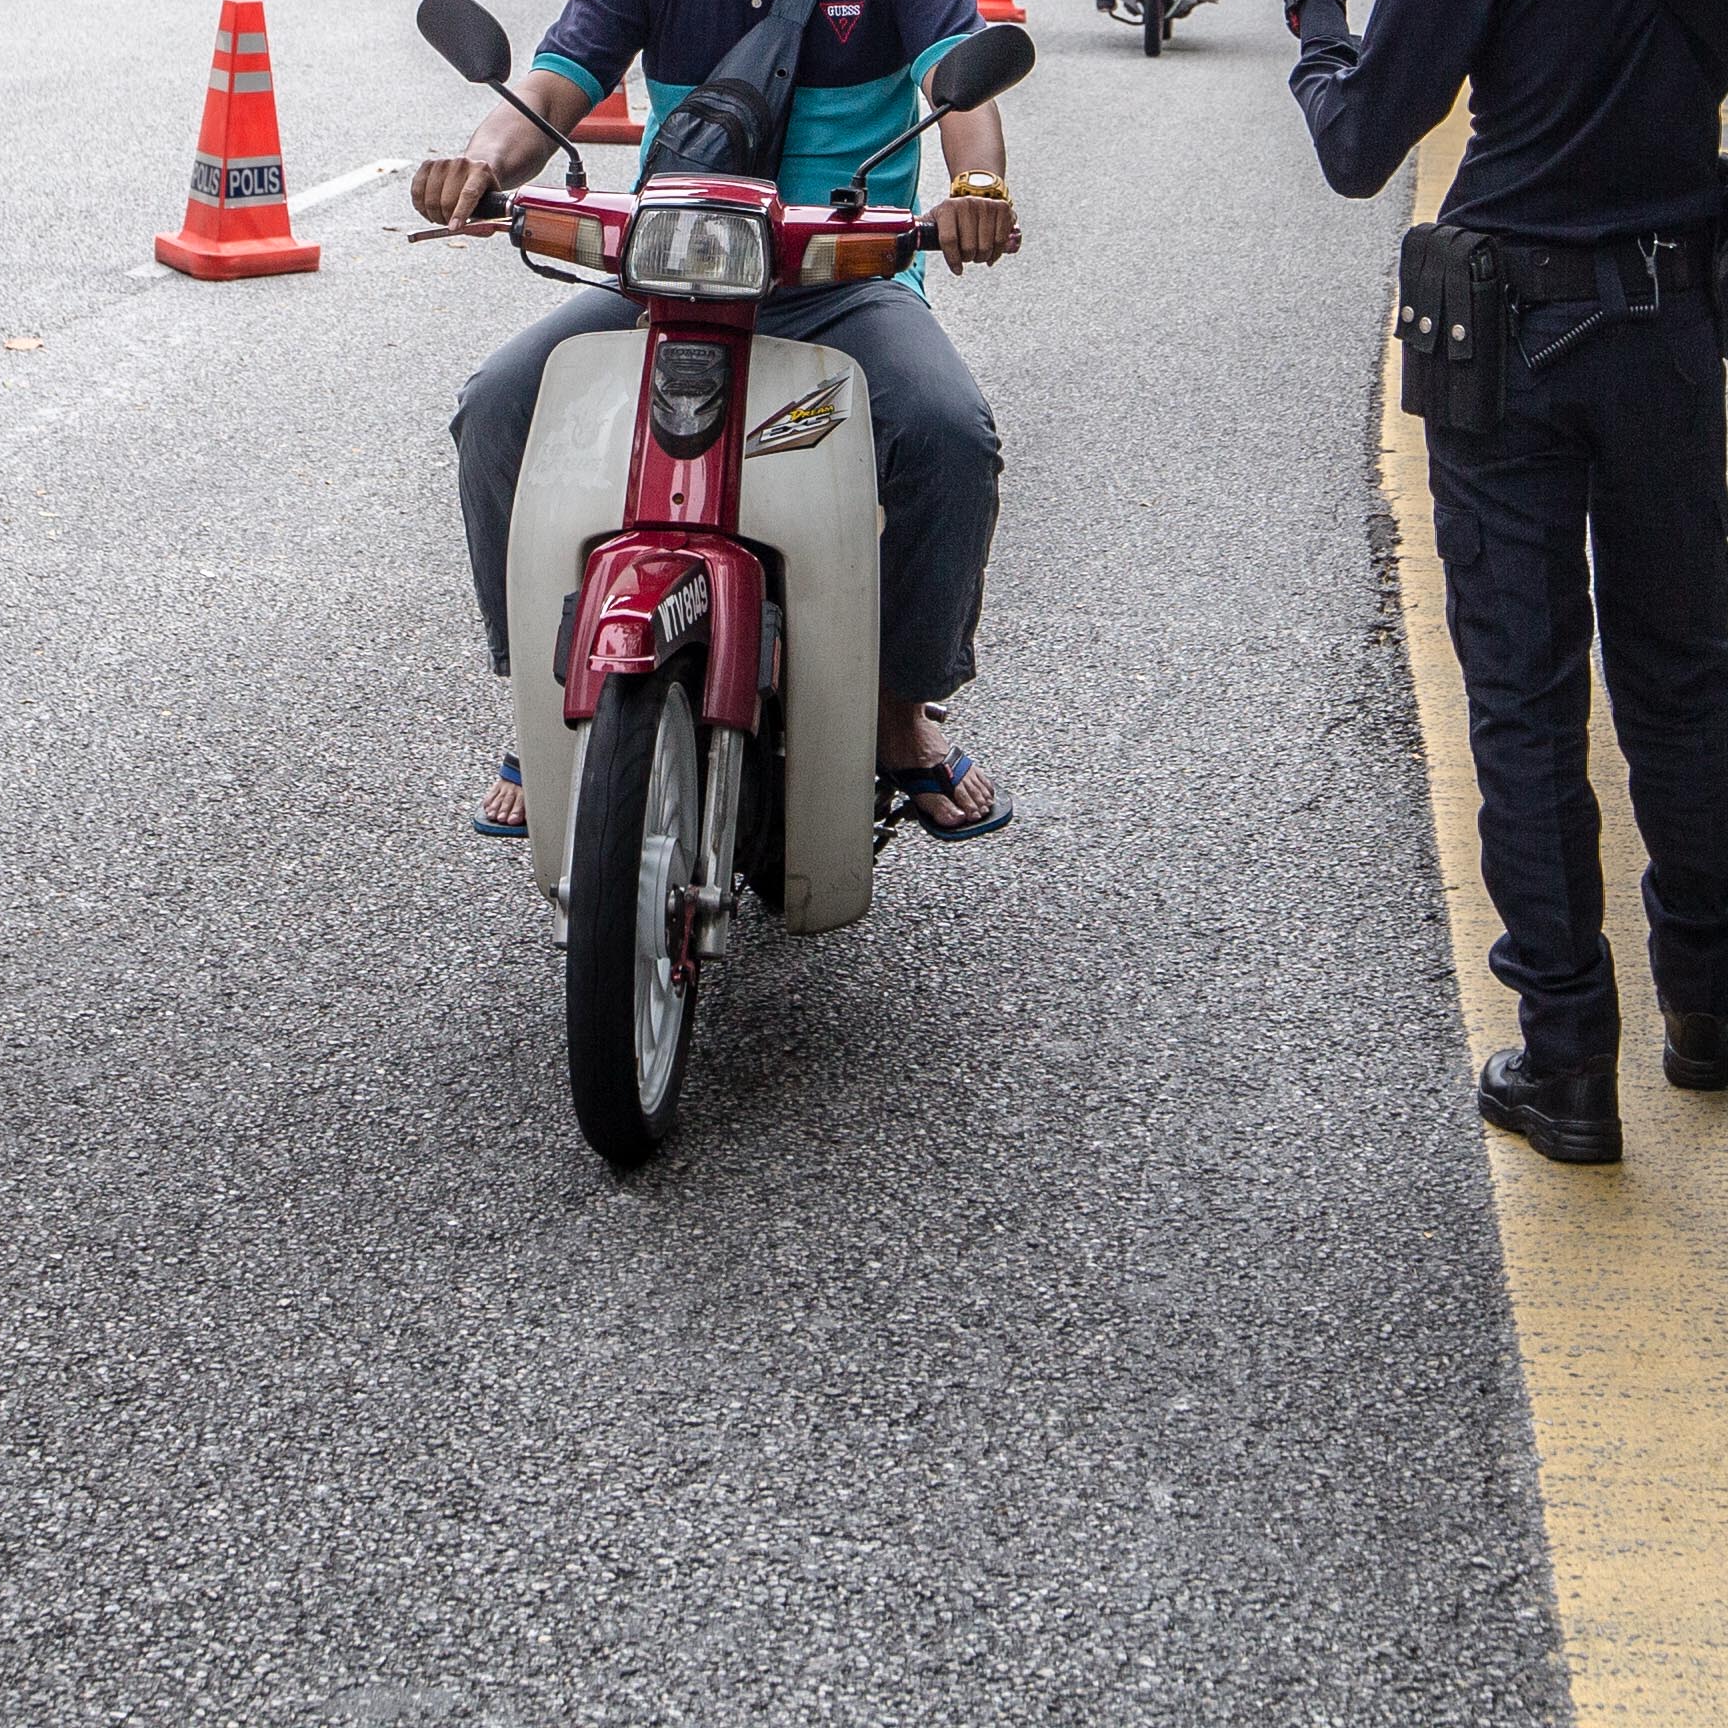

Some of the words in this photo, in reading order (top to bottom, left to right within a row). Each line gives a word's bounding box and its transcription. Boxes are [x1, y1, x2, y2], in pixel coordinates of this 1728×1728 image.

[827, 4, 861, 17] GUESS
[229, 166, 281, 197] POLIS
[657, 573, 709, 643] WTV8149
